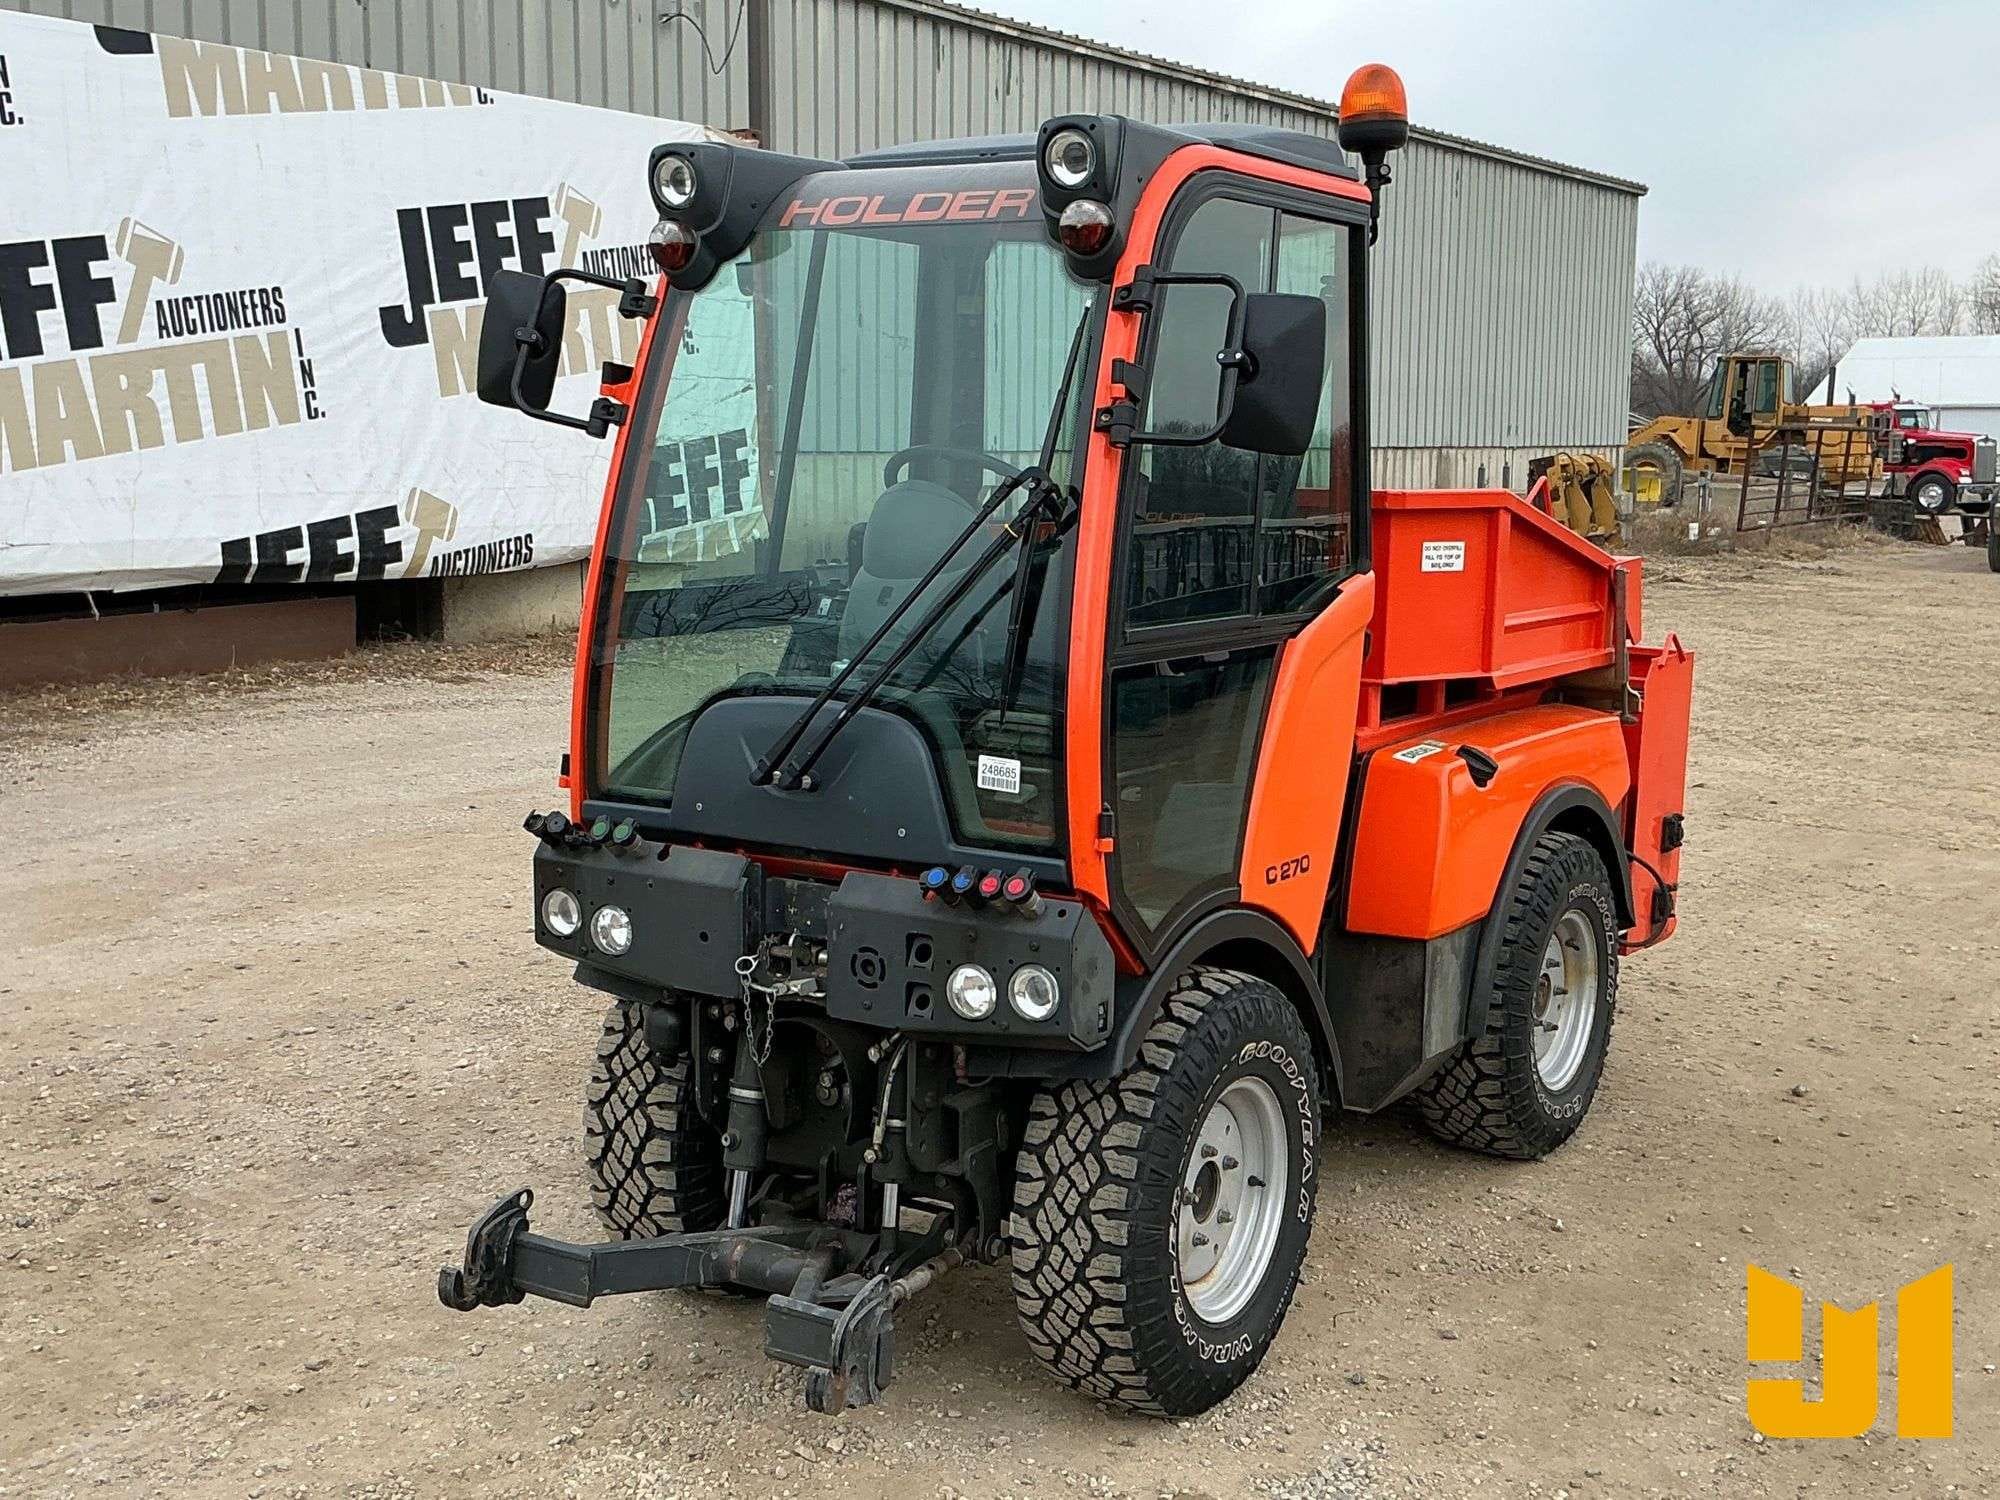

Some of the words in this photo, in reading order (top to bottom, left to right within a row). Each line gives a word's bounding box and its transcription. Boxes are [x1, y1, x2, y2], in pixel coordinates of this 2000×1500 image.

[779, 188, 1036, 227] HOLDER
[379, 196, 556, 348] JEFF
[155, 286, 287, 339] AUCTIONEERS
[430, 533, 534, 577] AUCTIONEERS
[982, 763, 1017, 779] 248685
[1280, 854, 1310, 881] 270
[1239, 1040, 1314, 1224] GOODYEAR
